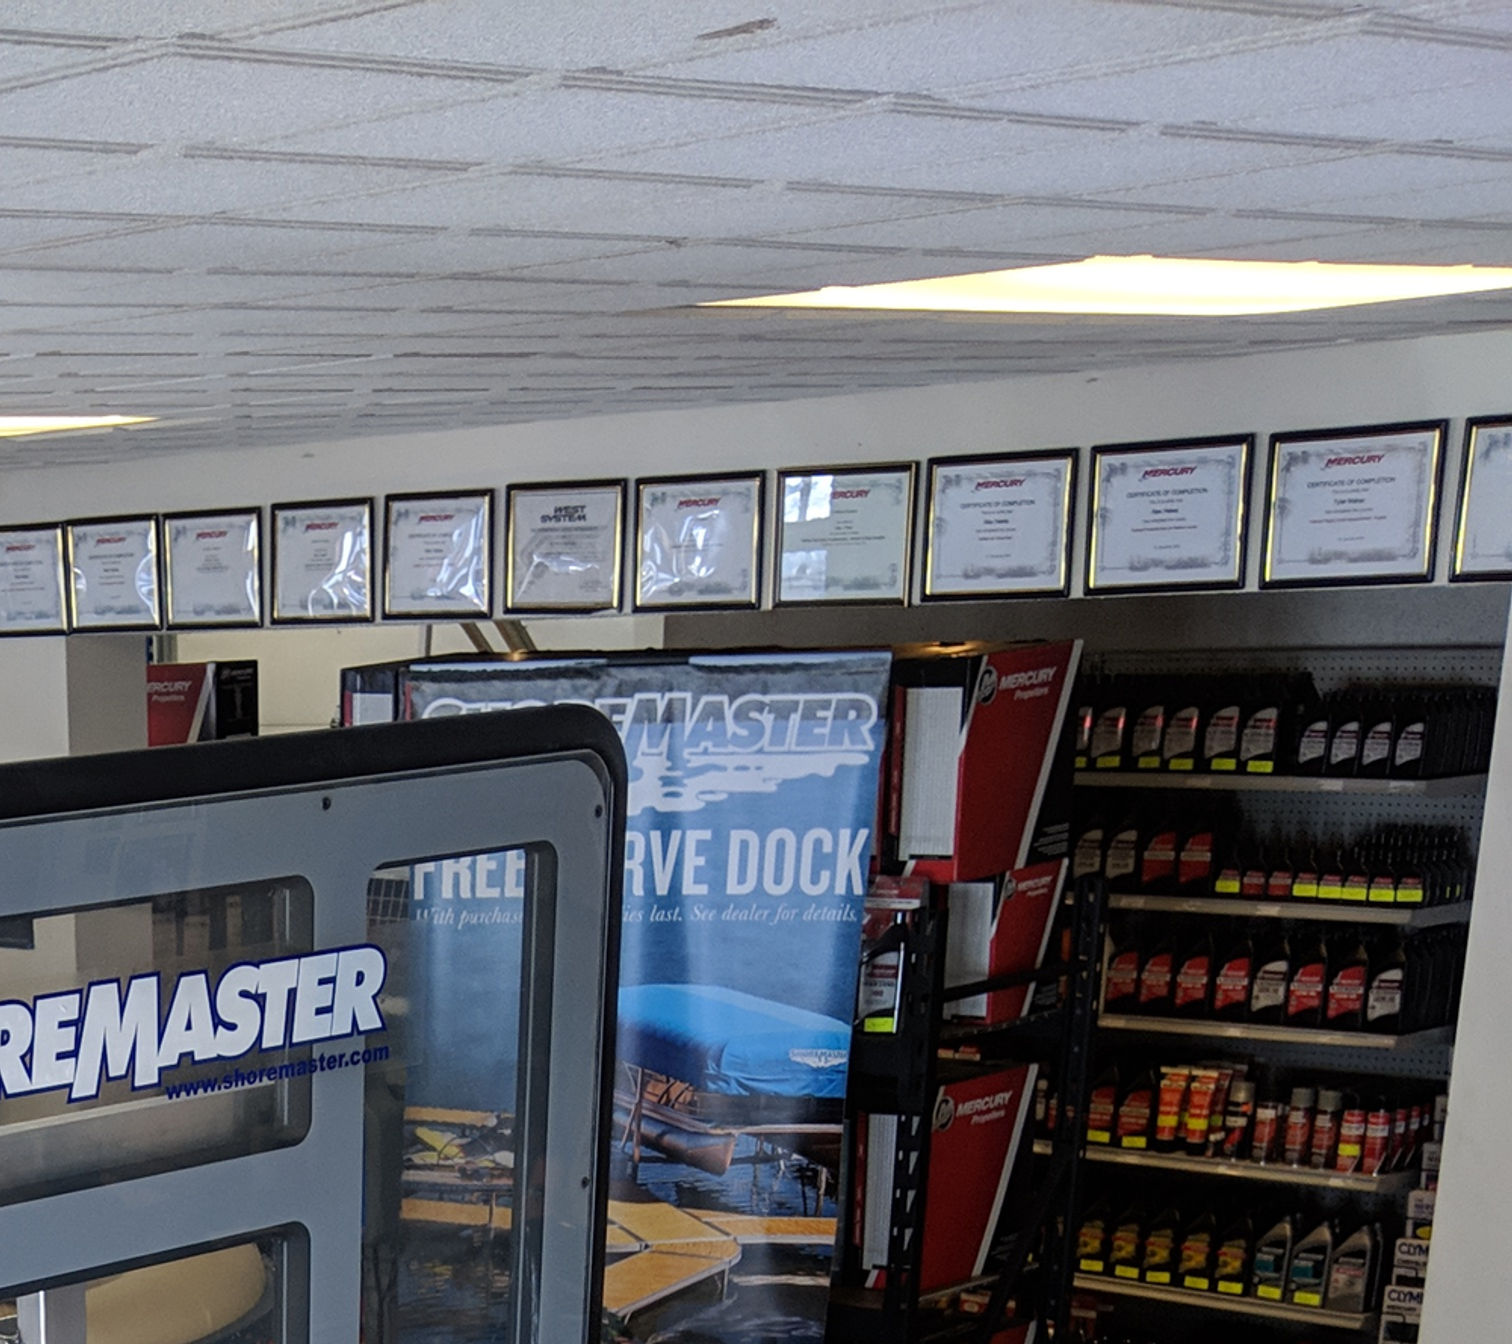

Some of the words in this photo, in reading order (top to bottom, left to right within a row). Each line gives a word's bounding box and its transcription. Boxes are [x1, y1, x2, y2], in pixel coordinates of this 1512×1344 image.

[1321, 454, 1384, 470] MERCURY
[1140, 465, 1197, 481] MERCURY
[972, 478, 1025, 493] MERCURY
[832, 488, 872, 500] ERCURY
[554, 504, 587, 514] WEST
[540, 513, 588, 523] SYSTEM
[999, 666, 1058, 690] MERCURY
[147, 681, 192, 693] ERCURY
[726, 827, 871, 896] DOCK
[650, 903, 682, 923] last.
[690, 902, 717, 922] See
[721, 902, 769, 923] dealer
[772, 902, 798, 926] for
[801, 902, 859, 923] details.
[166, 1043, 390, 1101] www.shoremaster.com
[956, 1090, 1013, 1117] MERCURY
